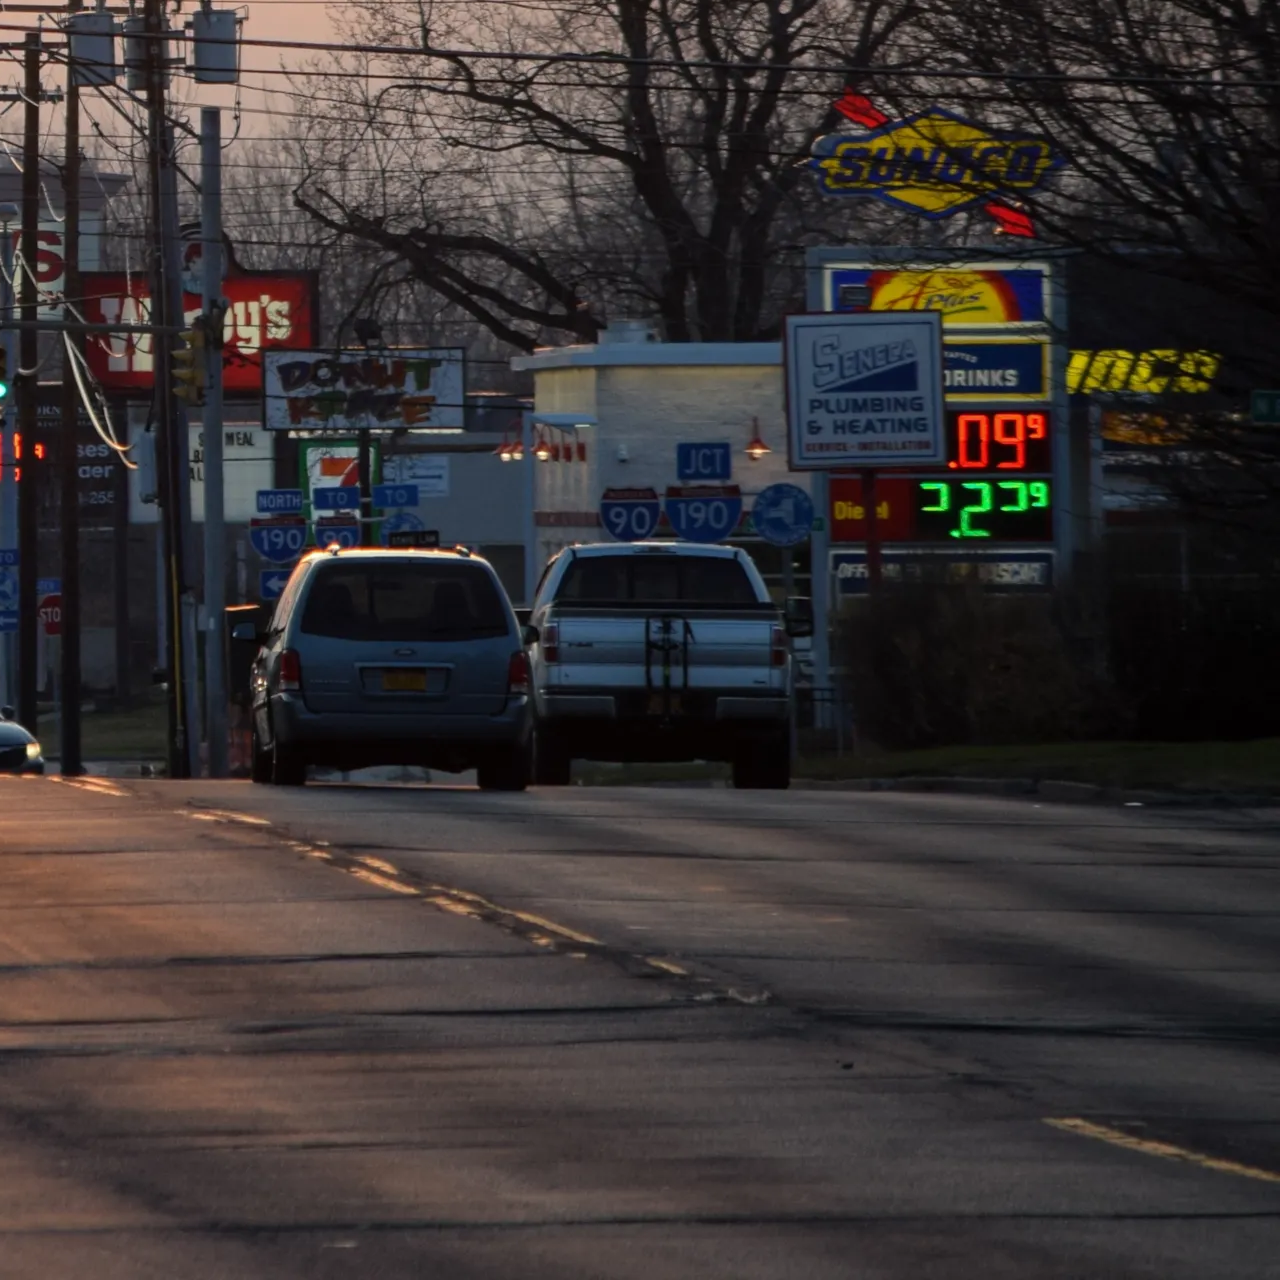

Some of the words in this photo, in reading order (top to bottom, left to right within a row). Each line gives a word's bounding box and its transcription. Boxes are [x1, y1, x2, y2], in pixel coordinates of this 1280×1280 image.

[833, 145, 1045, 184] SUNOCO
[813, 334, 917, 388] SENECA
[276, 359, 441, 391] DONUT
[809, 397, 924, 415] PLUMBING
[833, 418, 928, 435] HEATING
[684, 448, 724, 474] JCT
[259, 493, 301, 510] NORTH
[326, 491, 348, 505] TO
[384, 490, 407, 503] TO
[609, 506, 651, 535] 90
[677, 501, 728, 530] 190
[260, 529, 302, 551] 190
[39, 607, 61, 623] STO
